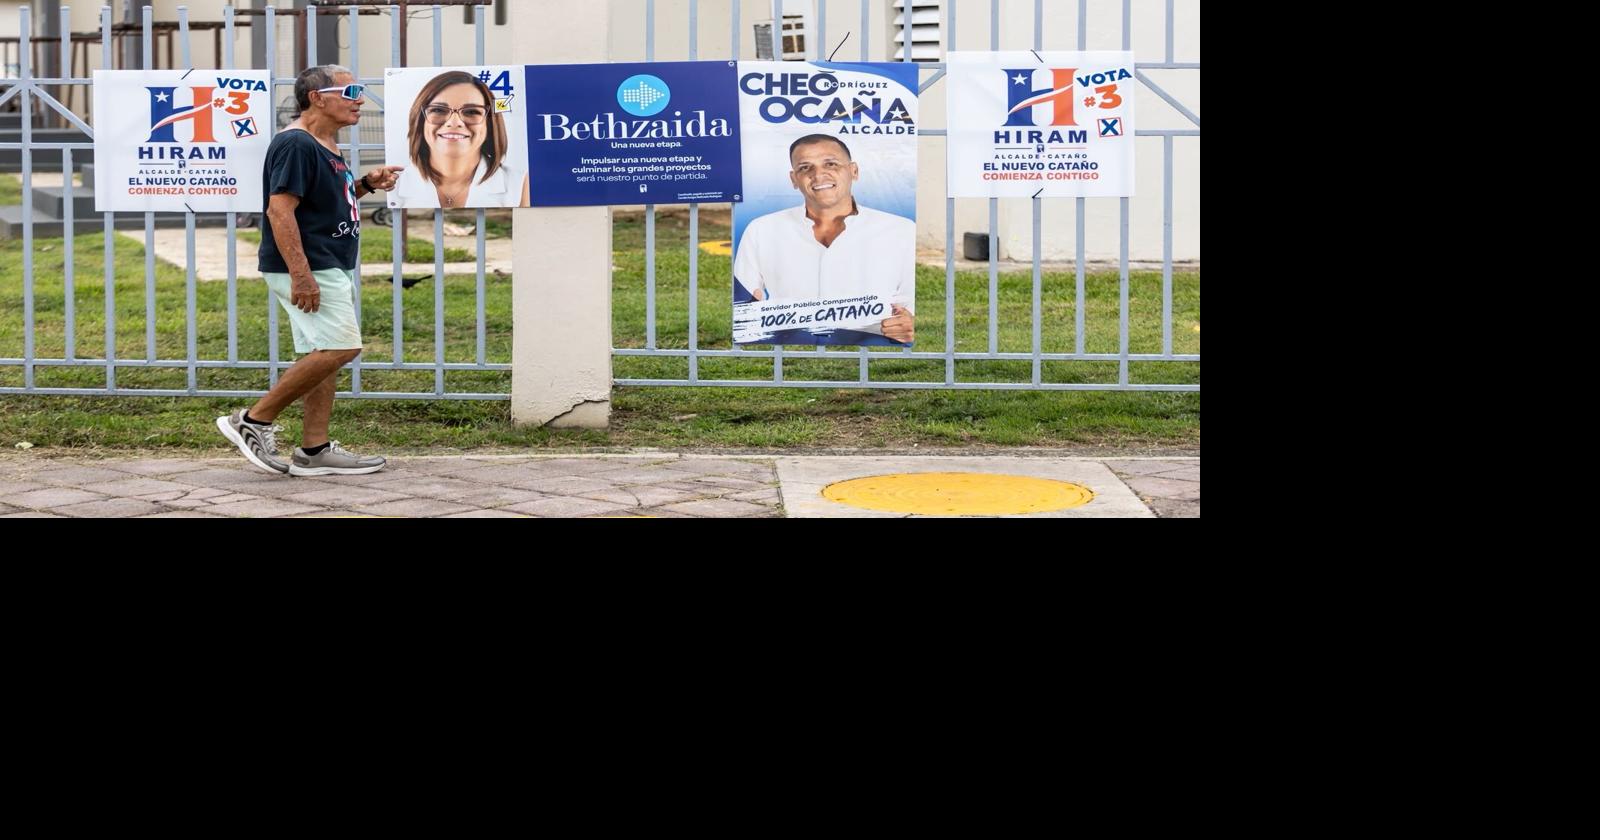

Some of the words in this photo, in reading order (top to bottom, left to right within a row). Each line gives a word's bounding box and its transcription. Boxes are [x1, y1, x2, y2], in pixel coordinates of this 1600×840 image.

[216, 77, 267, 92] VOTA
[478, 70, 514, 96] #4
[739, 72, 839, 96] CHEO
[823, 81, 888, 89] RODRÍGUEZ
[1076, 68, 1132, 88] VOTA
[213, 91, 250, 115] #3
[1083, 84, 1122, 109] #3
[759, 90, 914, 124] OCAÑA
[536, 110, 733, 141] Bethzaida
[838, 125, 915, 135] ALCALDE
[994, 130, 1087, 144] HIRAM
[138, 146, 226, 160] HIRAM
[581, 157, 621, 165] Impulsar
[669, 155, 695, 164] etapa
[572, 165, 612, 173] culminar
[613, 165, 626, 173] los
[627, 164, 665, 173] grandes
[666, 163, 712, 172] proyectos
[983, 162, 998, 171] EL
[1001, 162, 1045, 171] NUEVO
[1048, 160, 1099, 171] CATAÑO
[128, 177, 144, 186] EL
[146, 177, 186, 186] NUEVO
[189, 176, 237, 186] CATAÑO
[576, 174, 596, 182] será
[597, 174, 631, 182] nuestro
[632, 173, 659, 182] punto
[674, 172, 708, 181] partida.
[983, 172, 1043, 180] COMIENZA
[1046, 172, 1099, 180] CONTIGO
[128, 187, 185, 195] COMIENZA
[188, 187, 237, 195] CONTIGO
[760, 303, 791, 312] Servidor
[793, 301, 821, 309] Público
[822, 294, 878, 307] Comprometido
[760, 312, 797, 328] 100%
[799, 314, 813, 324] DE
[814, 300, 884, 322] CATAÑO
